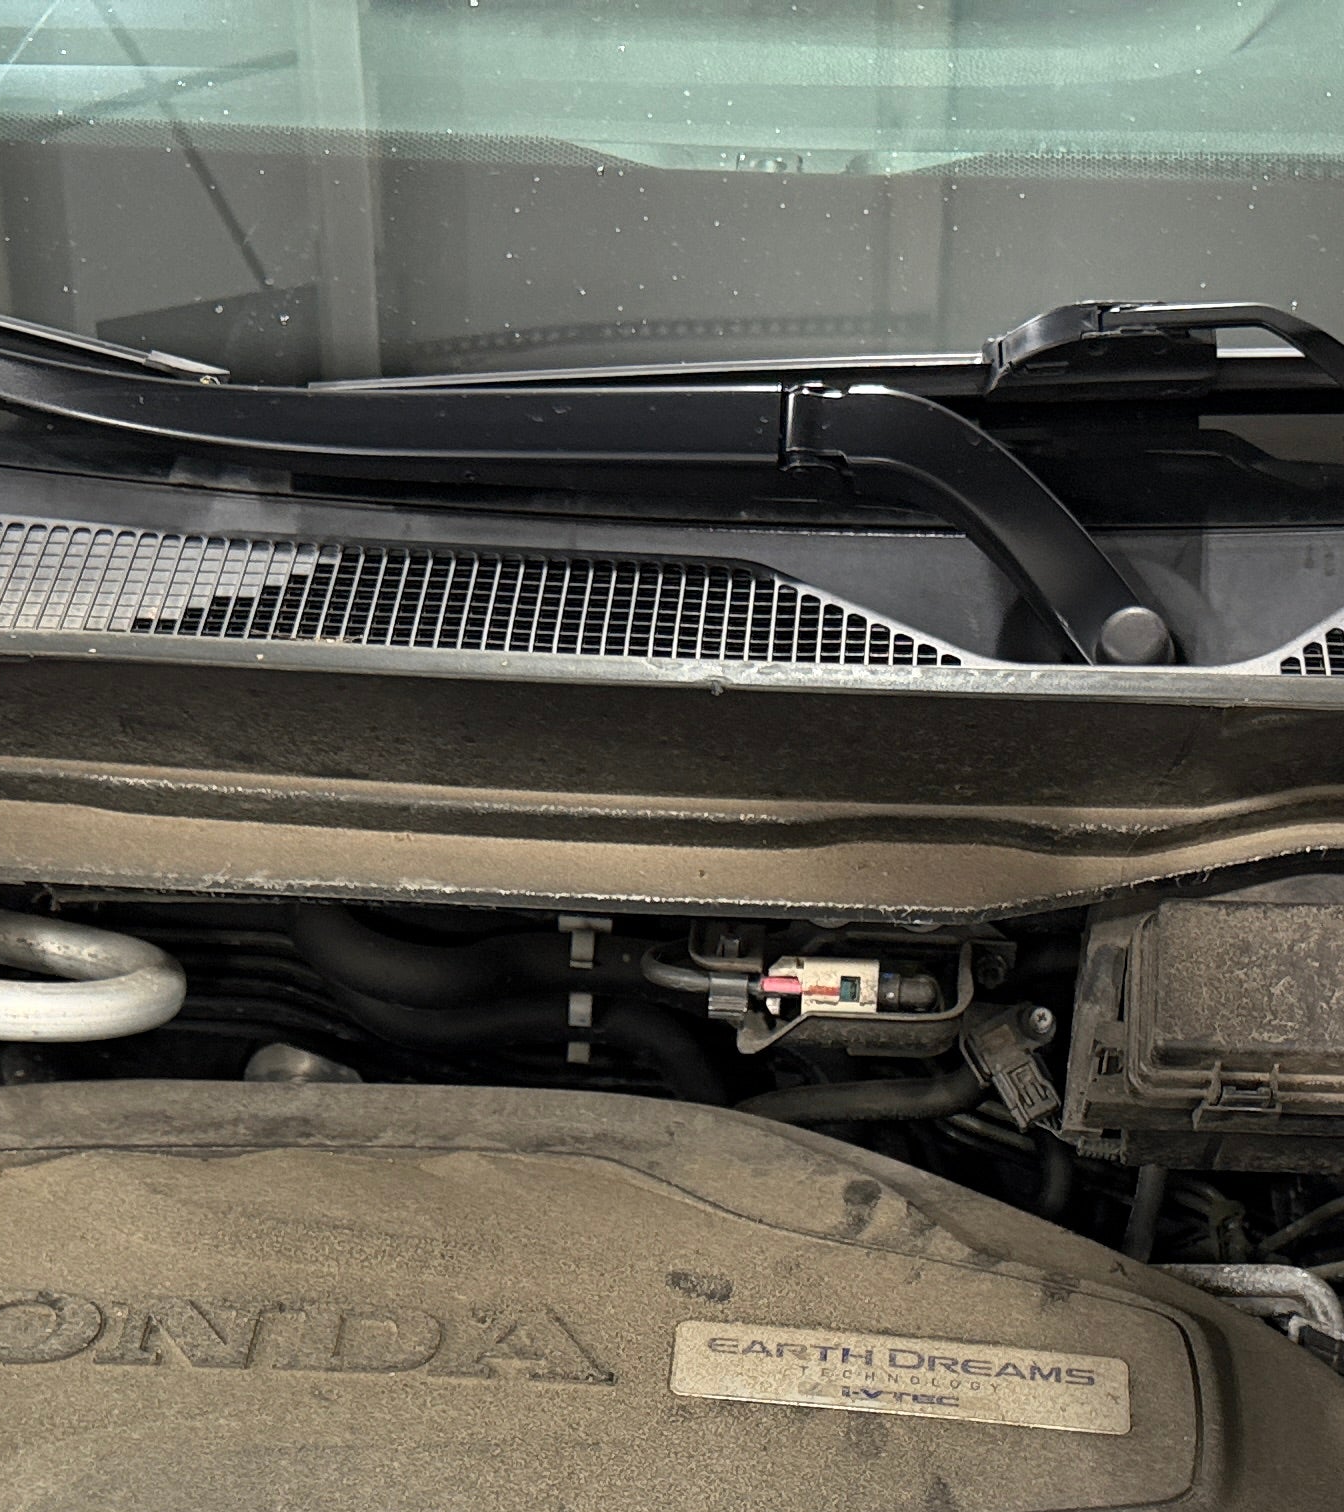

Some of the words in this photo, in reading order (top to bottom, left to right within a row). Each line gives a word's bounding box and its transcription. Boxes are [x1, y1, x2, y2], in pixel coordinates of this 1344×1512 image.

[707, 1337, 874, 1367] EARTH
[887, 1348, 1096, 1387] DREAMS
[799, 1365, 1001, 1393] TECHNOLOGY
